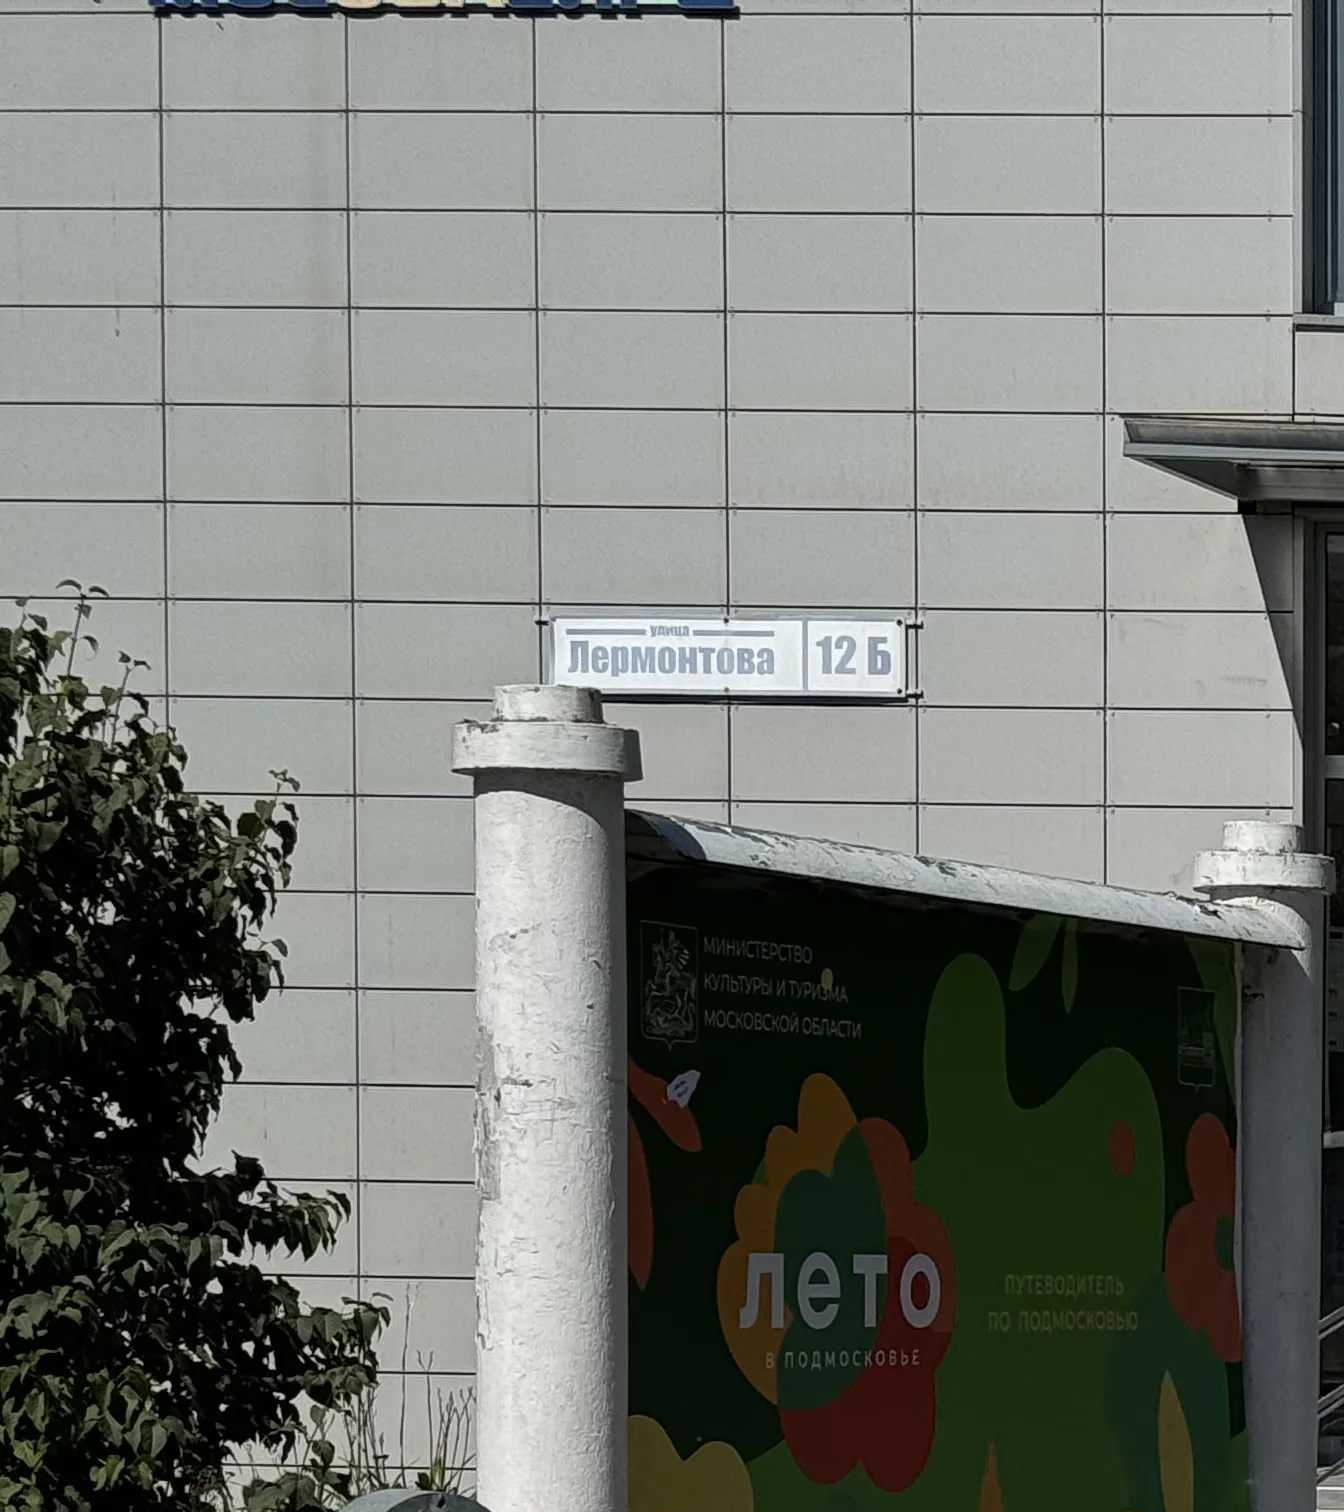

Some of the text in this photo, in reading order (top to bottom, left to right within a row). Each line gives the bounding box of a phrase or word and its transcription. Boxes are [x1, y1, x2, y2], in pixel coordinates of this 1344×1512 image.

[568, 640, 775, 677] Лермонтова
[815, 635, 892, 676] 12 Б
[703, 936, 814, 965] МИНИСТЕРСТВО
[703, 972, 849, 1004] КУЛЬТУРЫ И ТУРИЗМА
[704, 1009, 864, 1041] МОСКОВСКОЙ ОБЛАСТИ
[1004, 1274, 1125, 1300] ПУТЕВОДИТЕЛЬ
[988, 1309, 1139, 1336] ПО ПОДМОСКОВЬЮ
[765, 1348, 921, 1371] В ПОДМОСКОВЬЕ
